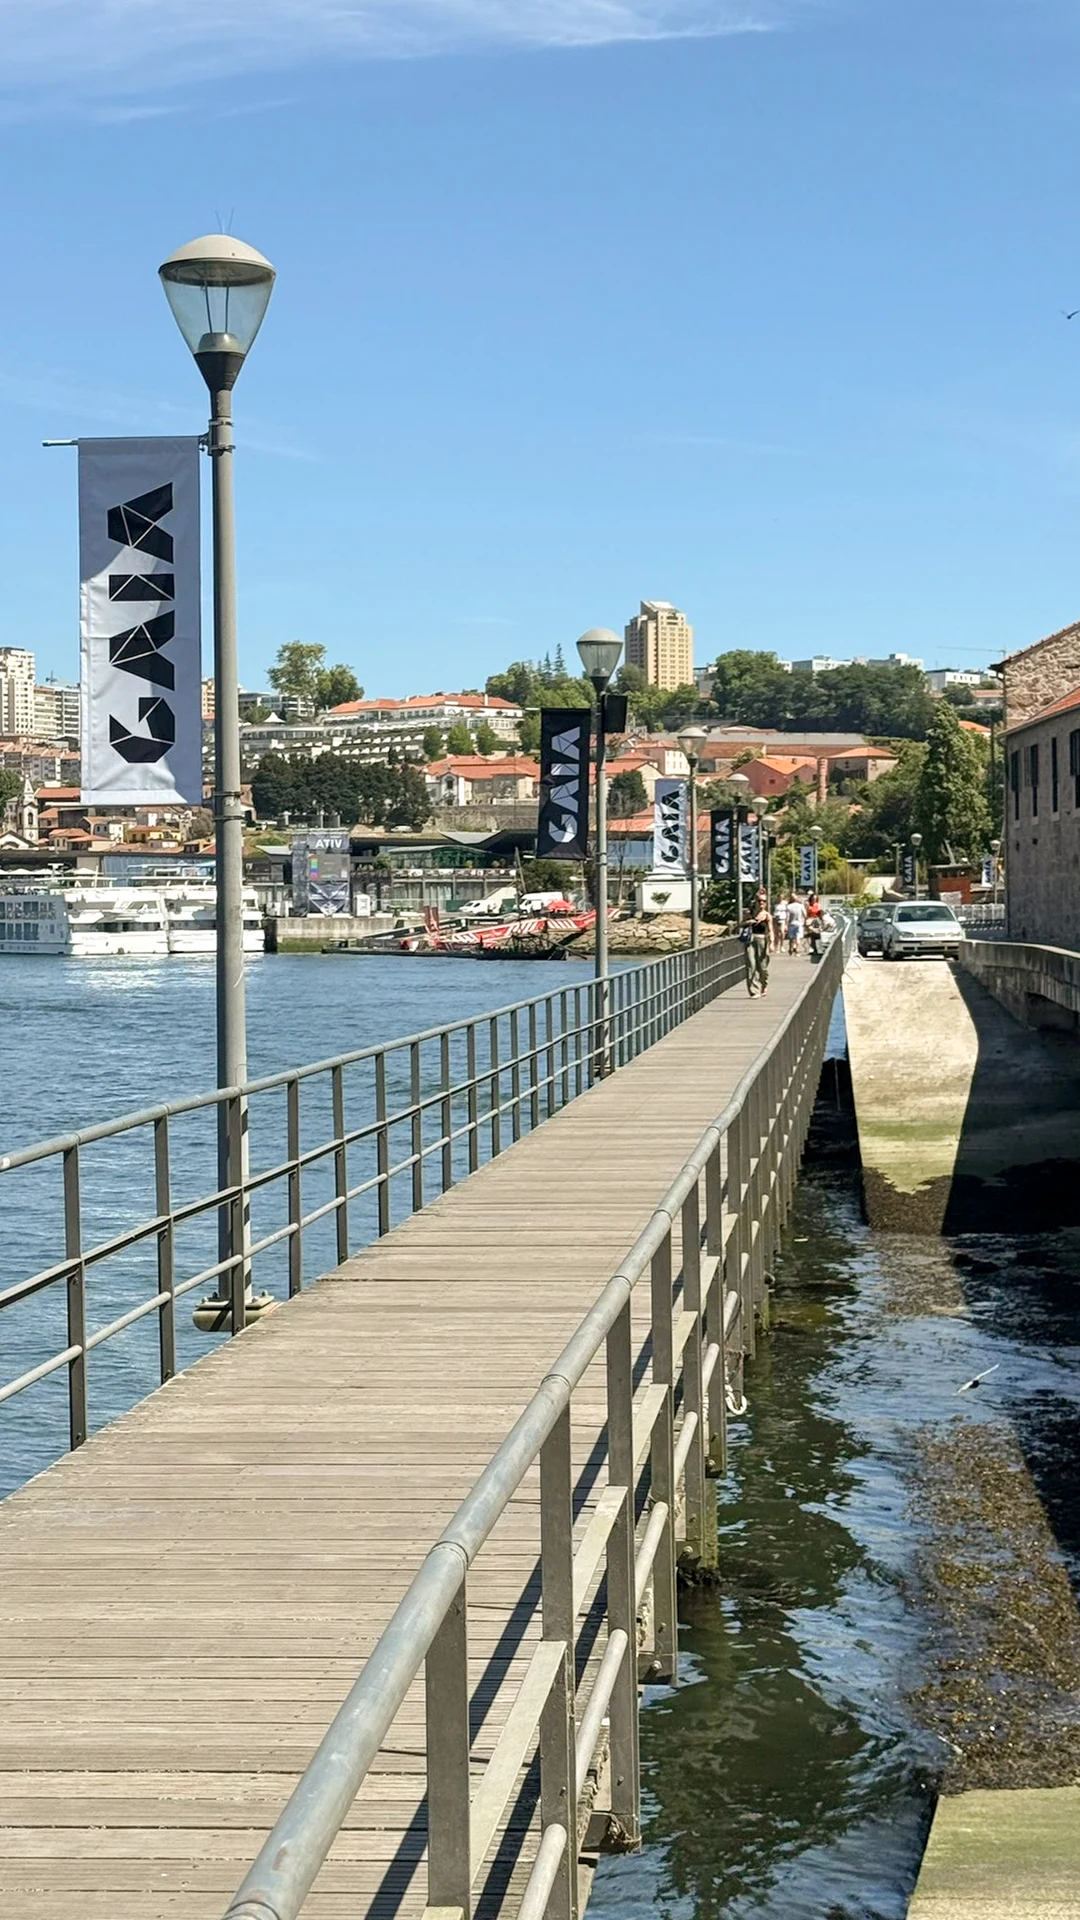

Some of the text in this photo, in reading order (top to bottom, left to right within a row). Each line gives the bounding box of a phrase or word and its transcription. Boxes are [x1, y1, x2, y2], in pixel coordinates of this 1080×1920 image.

[107, 481, 176, 764] GAIA
[548, 726, 581, 843] GAIA
[660, 790, 680, 863] GAIA
[714, 818, 730, 874] GAIA
[741, 832, 752, 875] GAIA
[803, 851, 811, 881] GAIA
[904, 856, 914, 883] GAIA
